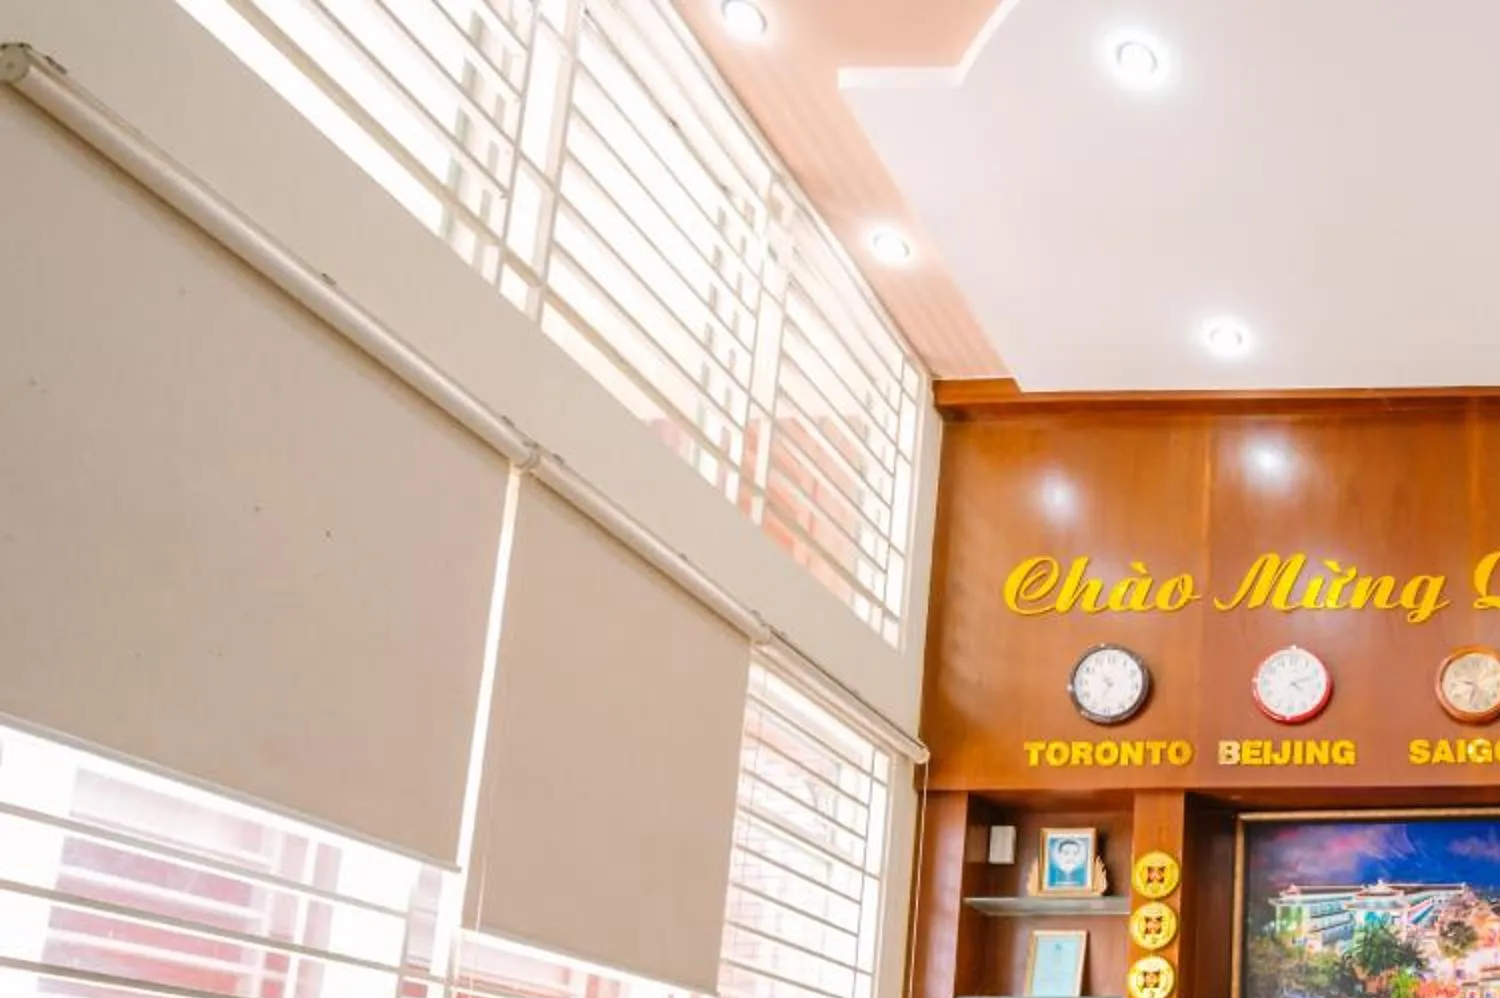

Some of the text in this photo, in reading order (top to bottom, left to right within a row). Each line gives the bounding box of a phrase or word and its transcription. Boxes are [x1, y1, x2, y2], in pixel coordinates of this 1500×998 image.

[1003, 554, 1200, 615] Chào
[1213, 552, 1451, 622] Mừng
[1024, 740, 1193, 766] TORONTO
[1218, 740, 1357, 766] BEIJING
